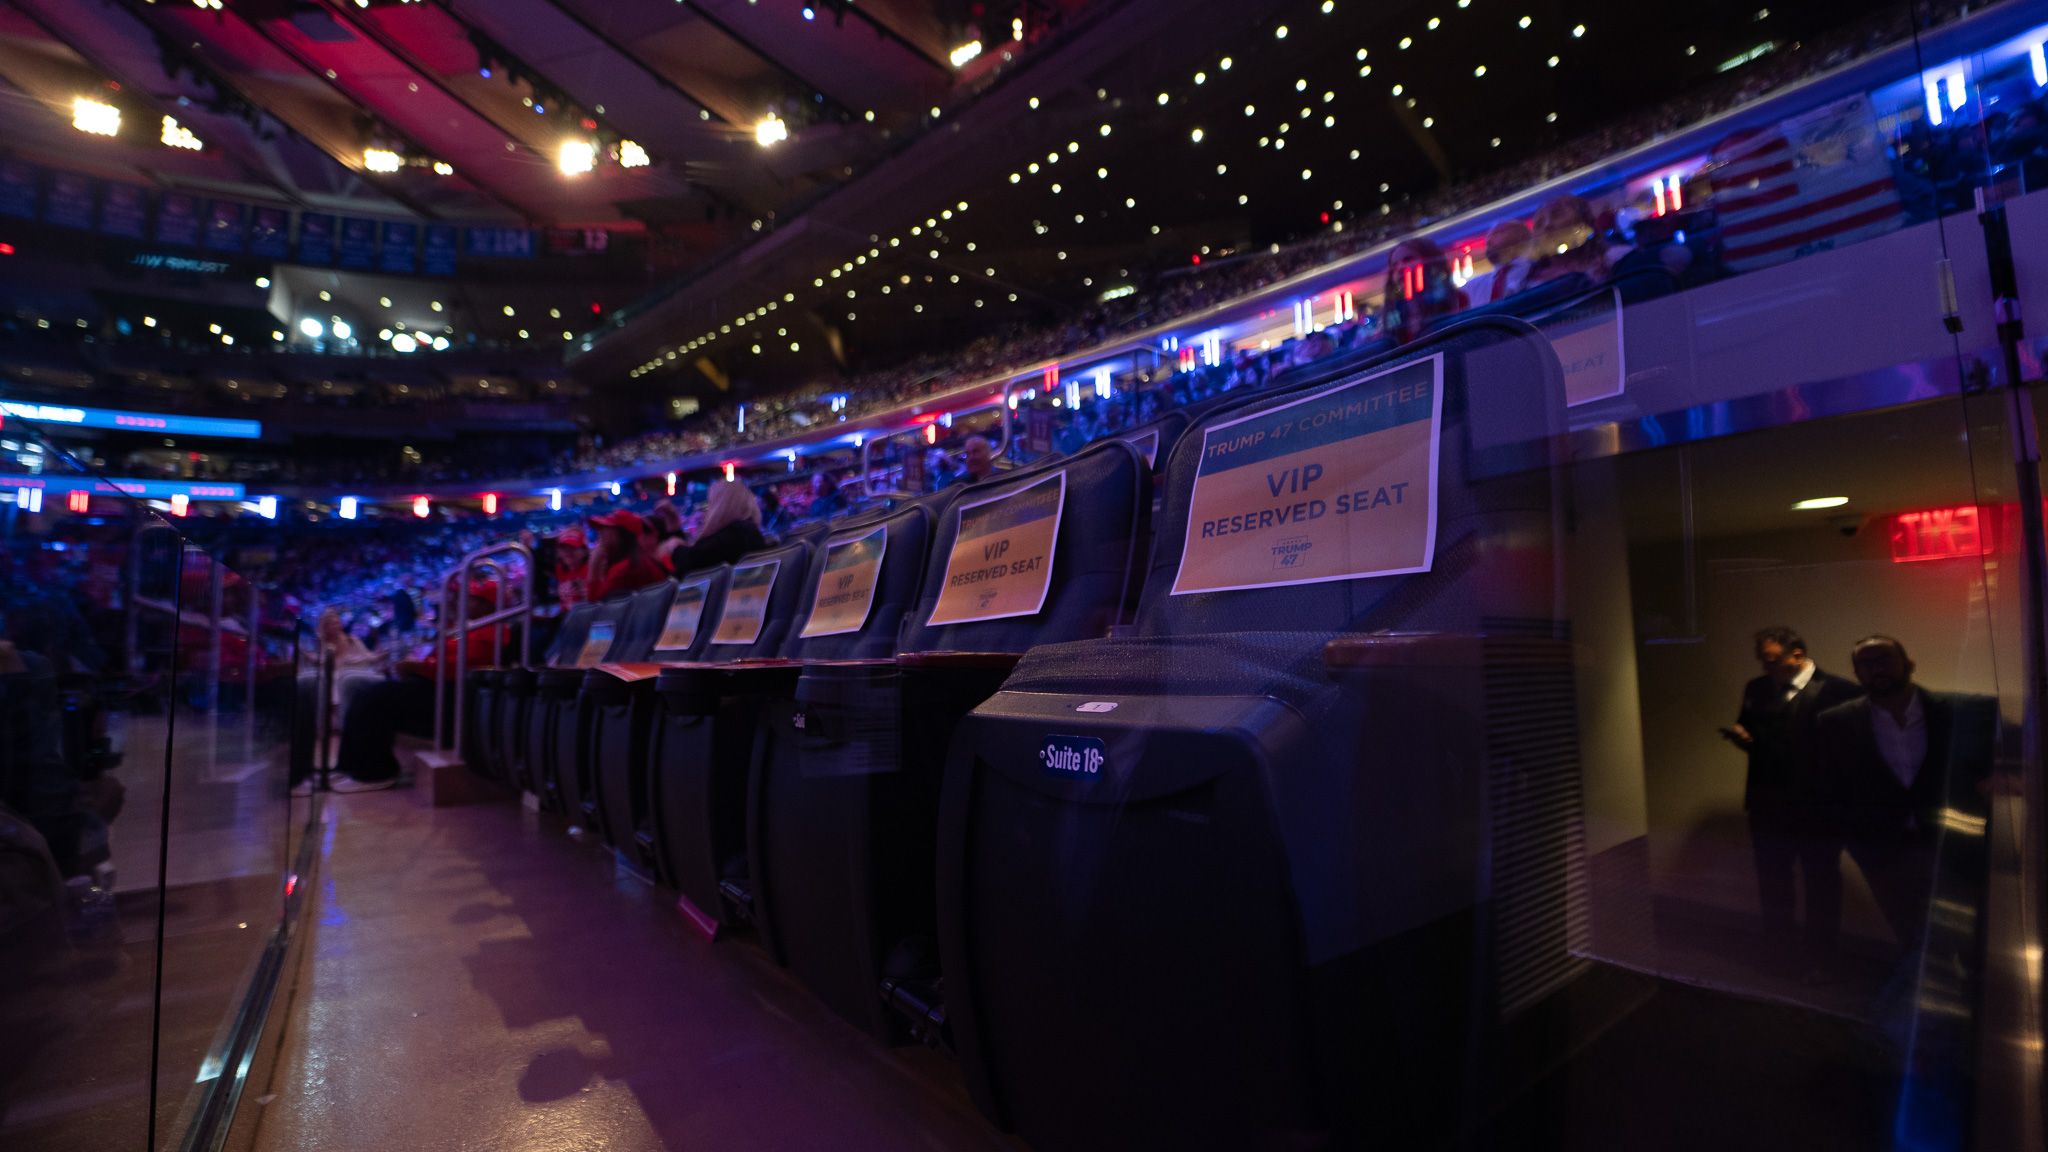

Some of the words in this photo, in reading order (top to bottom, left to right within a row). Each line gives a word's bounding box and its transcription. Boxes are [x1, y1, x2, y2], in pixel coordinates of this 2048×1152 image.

[1208, 431, 1266, 459] TRUMP
[1270, 422, 1293, 440] 47
[1298, 381, 1429, 432] COMMITTEE
[1266, 463, 1324, 498] VIP
[1201, 499, 1326, 539] RESERVED
[1335, 482, 1410, 515] SEAT
[984, 540, 1010, 562] VIP
[1271, 541, 1313, 556] TRUMP
[1280, 554, 1298, 566] 47
[838, 574, 854, 589] VIP
[950, 564, 1008, 587] RESERVED
[1010, 556, 1043, 575] SEAT
[819, 593, 851, 608] RESERVED
[851, 588, 871, 602] SEAT
[1045, 743, 1081, 772] Suite
[1083, 747, 1099, 774] 18
